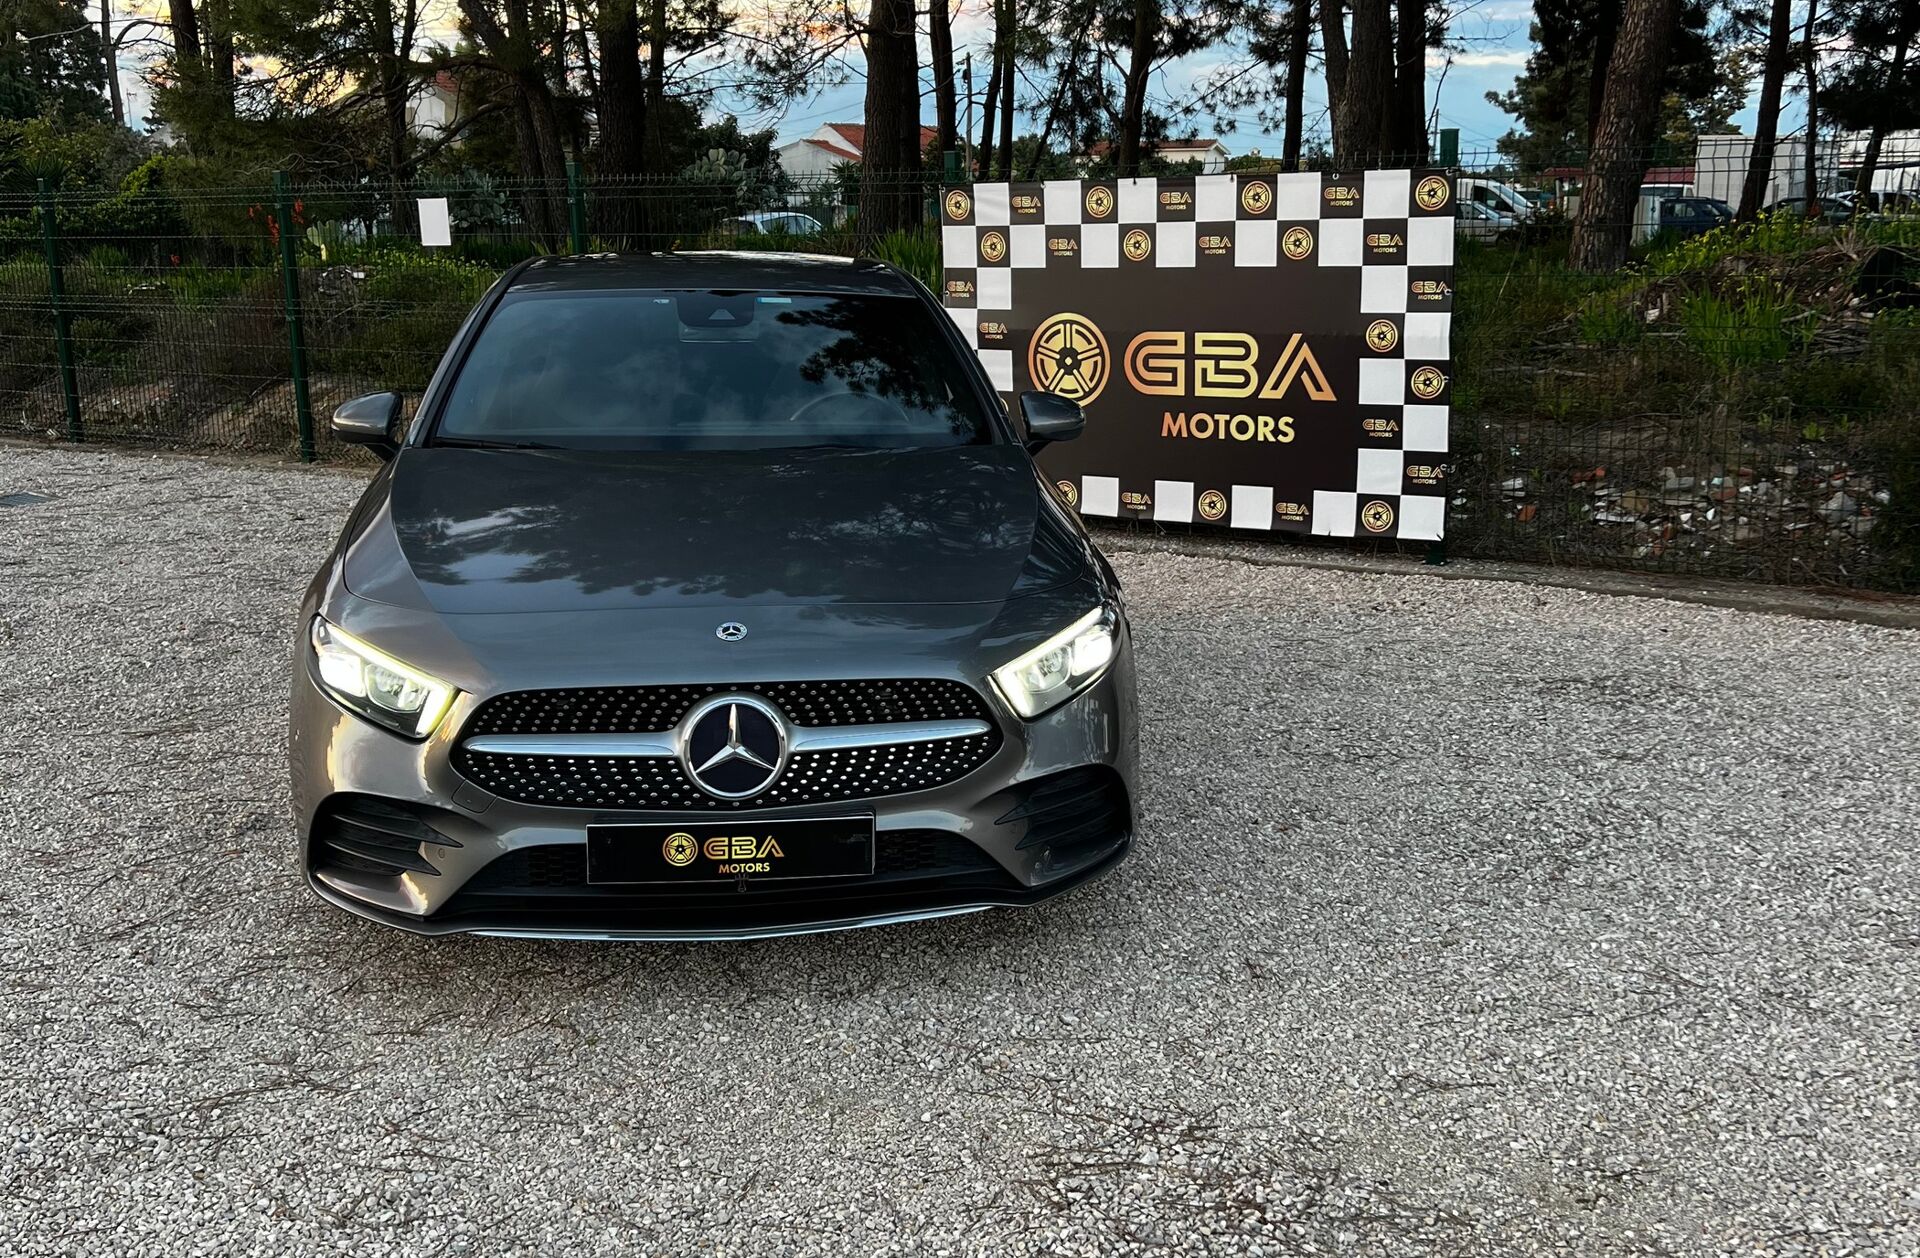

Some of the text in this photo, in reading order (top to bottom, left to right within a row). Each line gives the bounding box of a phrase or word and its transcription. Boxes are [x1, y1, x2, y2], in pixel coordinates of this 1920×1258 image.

[1159, 191, 1192, 204] GBA
[1323, 186, 1360, 200] GBA
[1011, 196, 1041, 208] GBA
[1048, 238, 1078, 250] GBA
[1199, 235, 1232, 248] GBA
[1366, 233, 1404, 247] GBA
[946, 280, 975, 292] GBA
[1411, 280, 1449, 294] GBA
[979, 322, 1008, 334] GBA
[1124, 331, 1337, 401] GBA
[1161, 411, 1295, 443] MOTORS
[1362, 418, 1399, 431] GBA
[1406, 465, 1444, 478] GBA
[1121, 492, 1152, 504] GBA
[1275, 502, 1310, 515] GBA
[703, 835, 785, 860] GBA
[718, 862, 771, 874] MOTORS
